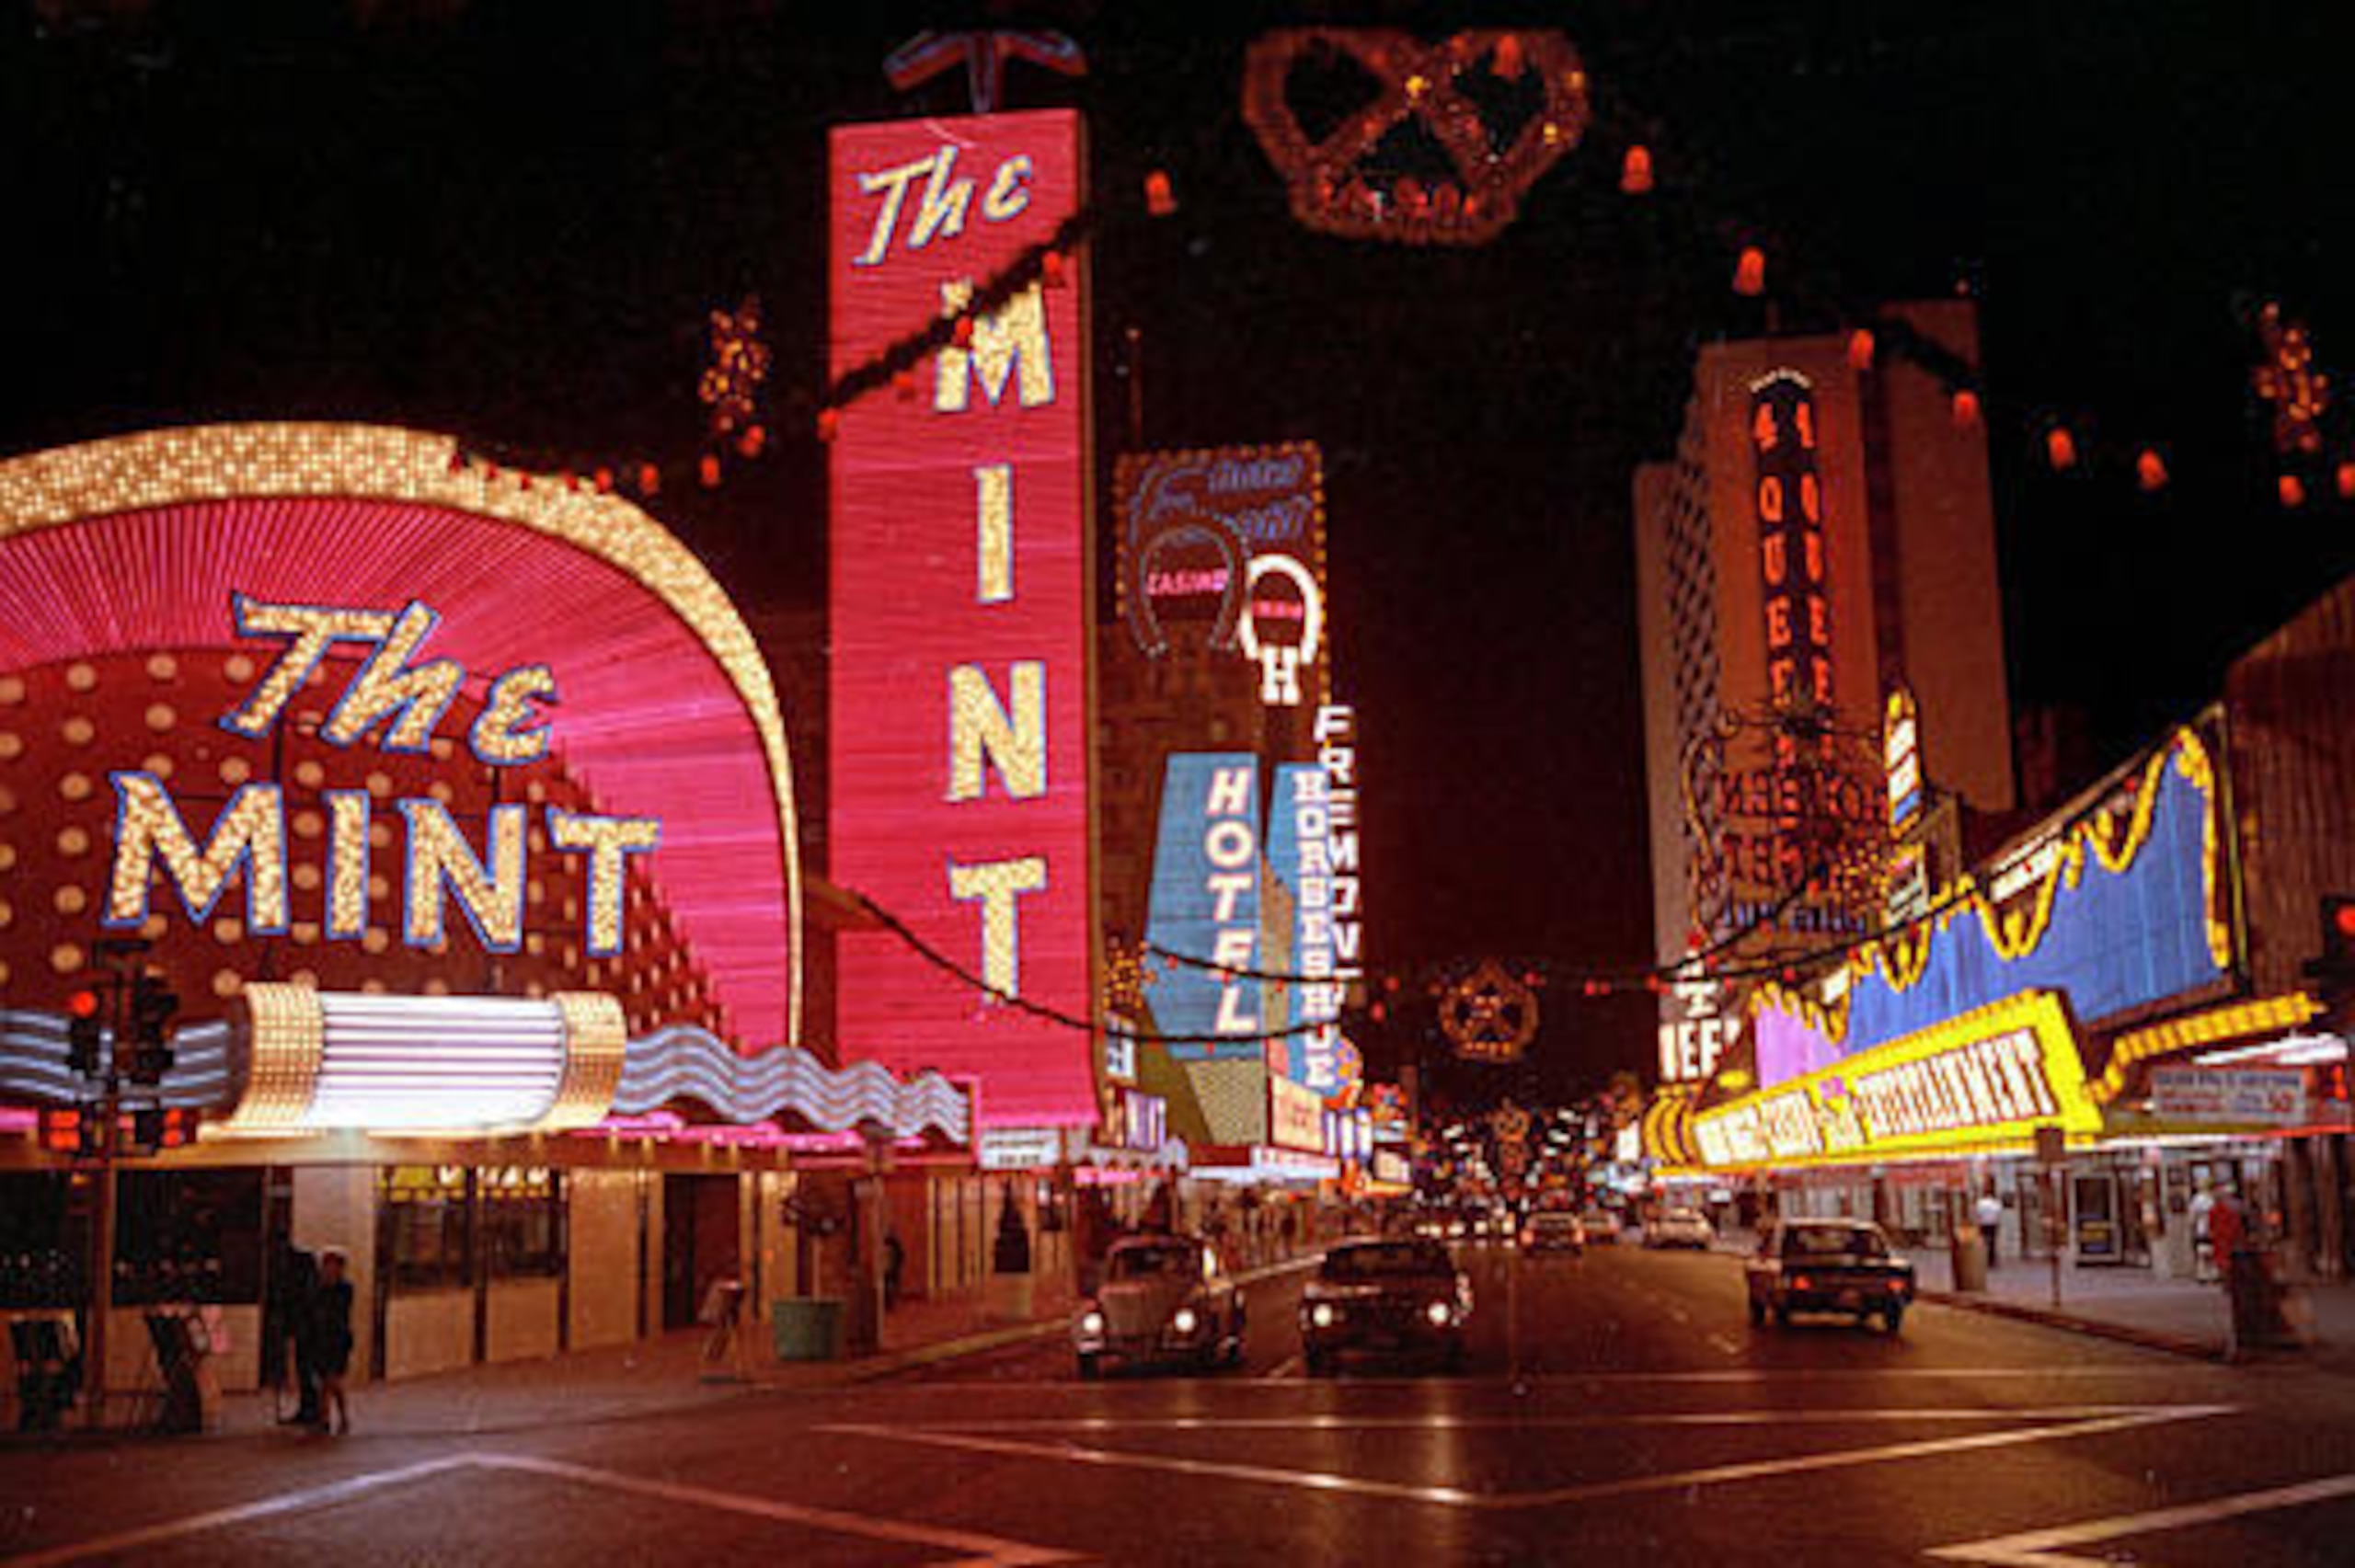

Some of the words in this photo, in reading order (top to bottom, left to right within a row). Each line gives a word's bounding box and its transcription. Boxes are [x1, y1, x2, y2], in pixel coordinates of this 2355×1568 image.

[852, 144, 1032, 267] The
[219, 591, 559, 765] The
[933, 276, 1056, 1005] MINT
[103, 769, 662, 957] MINT
[1205, 767, 1257, 1034] HOTEL
